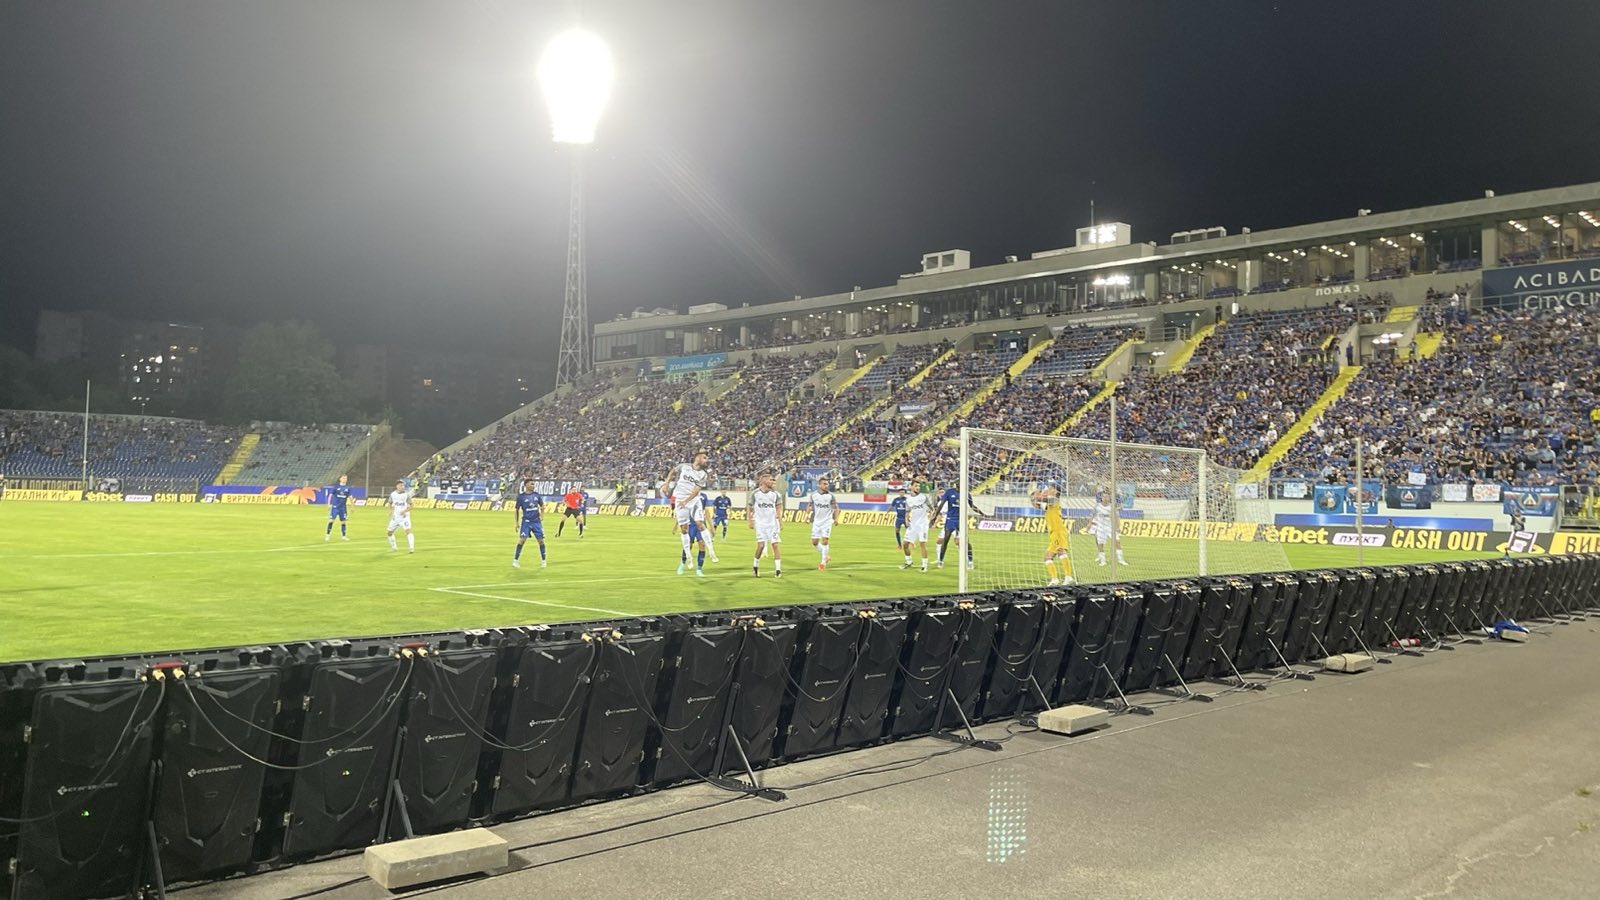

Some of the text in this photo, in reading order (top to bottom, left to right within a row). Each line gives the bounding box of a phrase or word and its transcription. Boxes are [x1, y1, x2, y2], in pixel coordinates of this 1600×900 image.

[1513, 268, 1600, 289] ACIBAD
[683, 474, 700, 487] efbe
[86, 491, 123, 502] efbet
[154, 493, 197, 503] CASH OUT
[727, 508, 746, 520] bet
[782, 510, 795, 522] SH
[843, 512, 897, 525] ВИРТУАЛНИ
[1015, 517, 1047, 533] CASH
[1121, 521, 1202, 538] ВИРТУАЛНИ
[1262, 525, 1329, 545] efbet
[1391, 529, 1488, 552] CASH OUT
